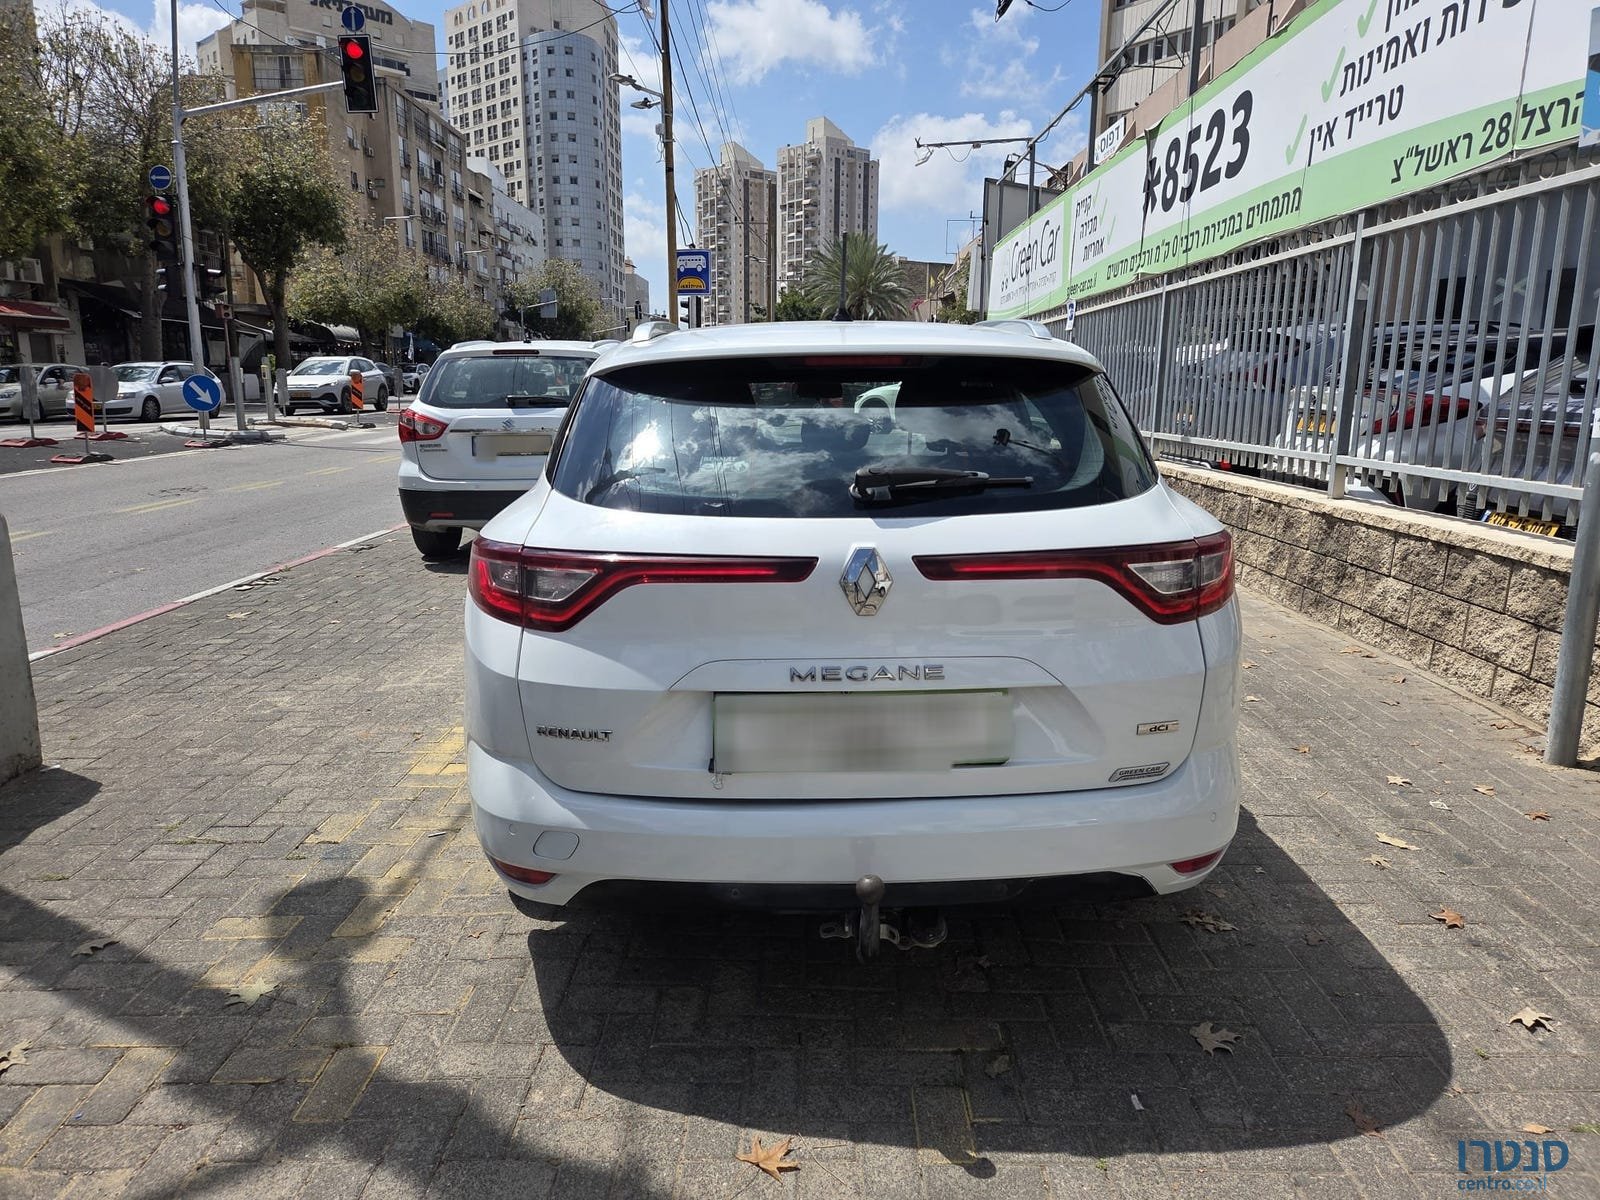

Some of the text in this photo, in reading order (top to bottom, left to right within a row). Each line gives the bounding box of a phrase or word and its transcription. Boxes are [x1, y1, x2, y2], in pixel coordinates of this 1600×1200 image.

[1340, 17, 1431, 97] ואמינות
[1307, 84, 1404, 167] טרייד אין
[1479, 112, 1512, 155] 28
[1100, 125, 1120, 153] דפוס
[1246, 187, 1302, 230] מתמחים
[1080, 216, 1098, 240] מכירה
[1202, 212, 1242, 247] במכירת
[1010, 219, 1061, 283] Green Car
[1083, 237, 1104, 262] אחריות
[1180, 230, 1200, 255] רכבי
[1107, 258, 1128, 280] חדשים
[1130, 248, 1153, 272] ורכבים
[789, 664, 945, 682] MEGANE
[536, 725, 613, 742] RENAULT
[1119, 767, 1144, 775] GREEN
